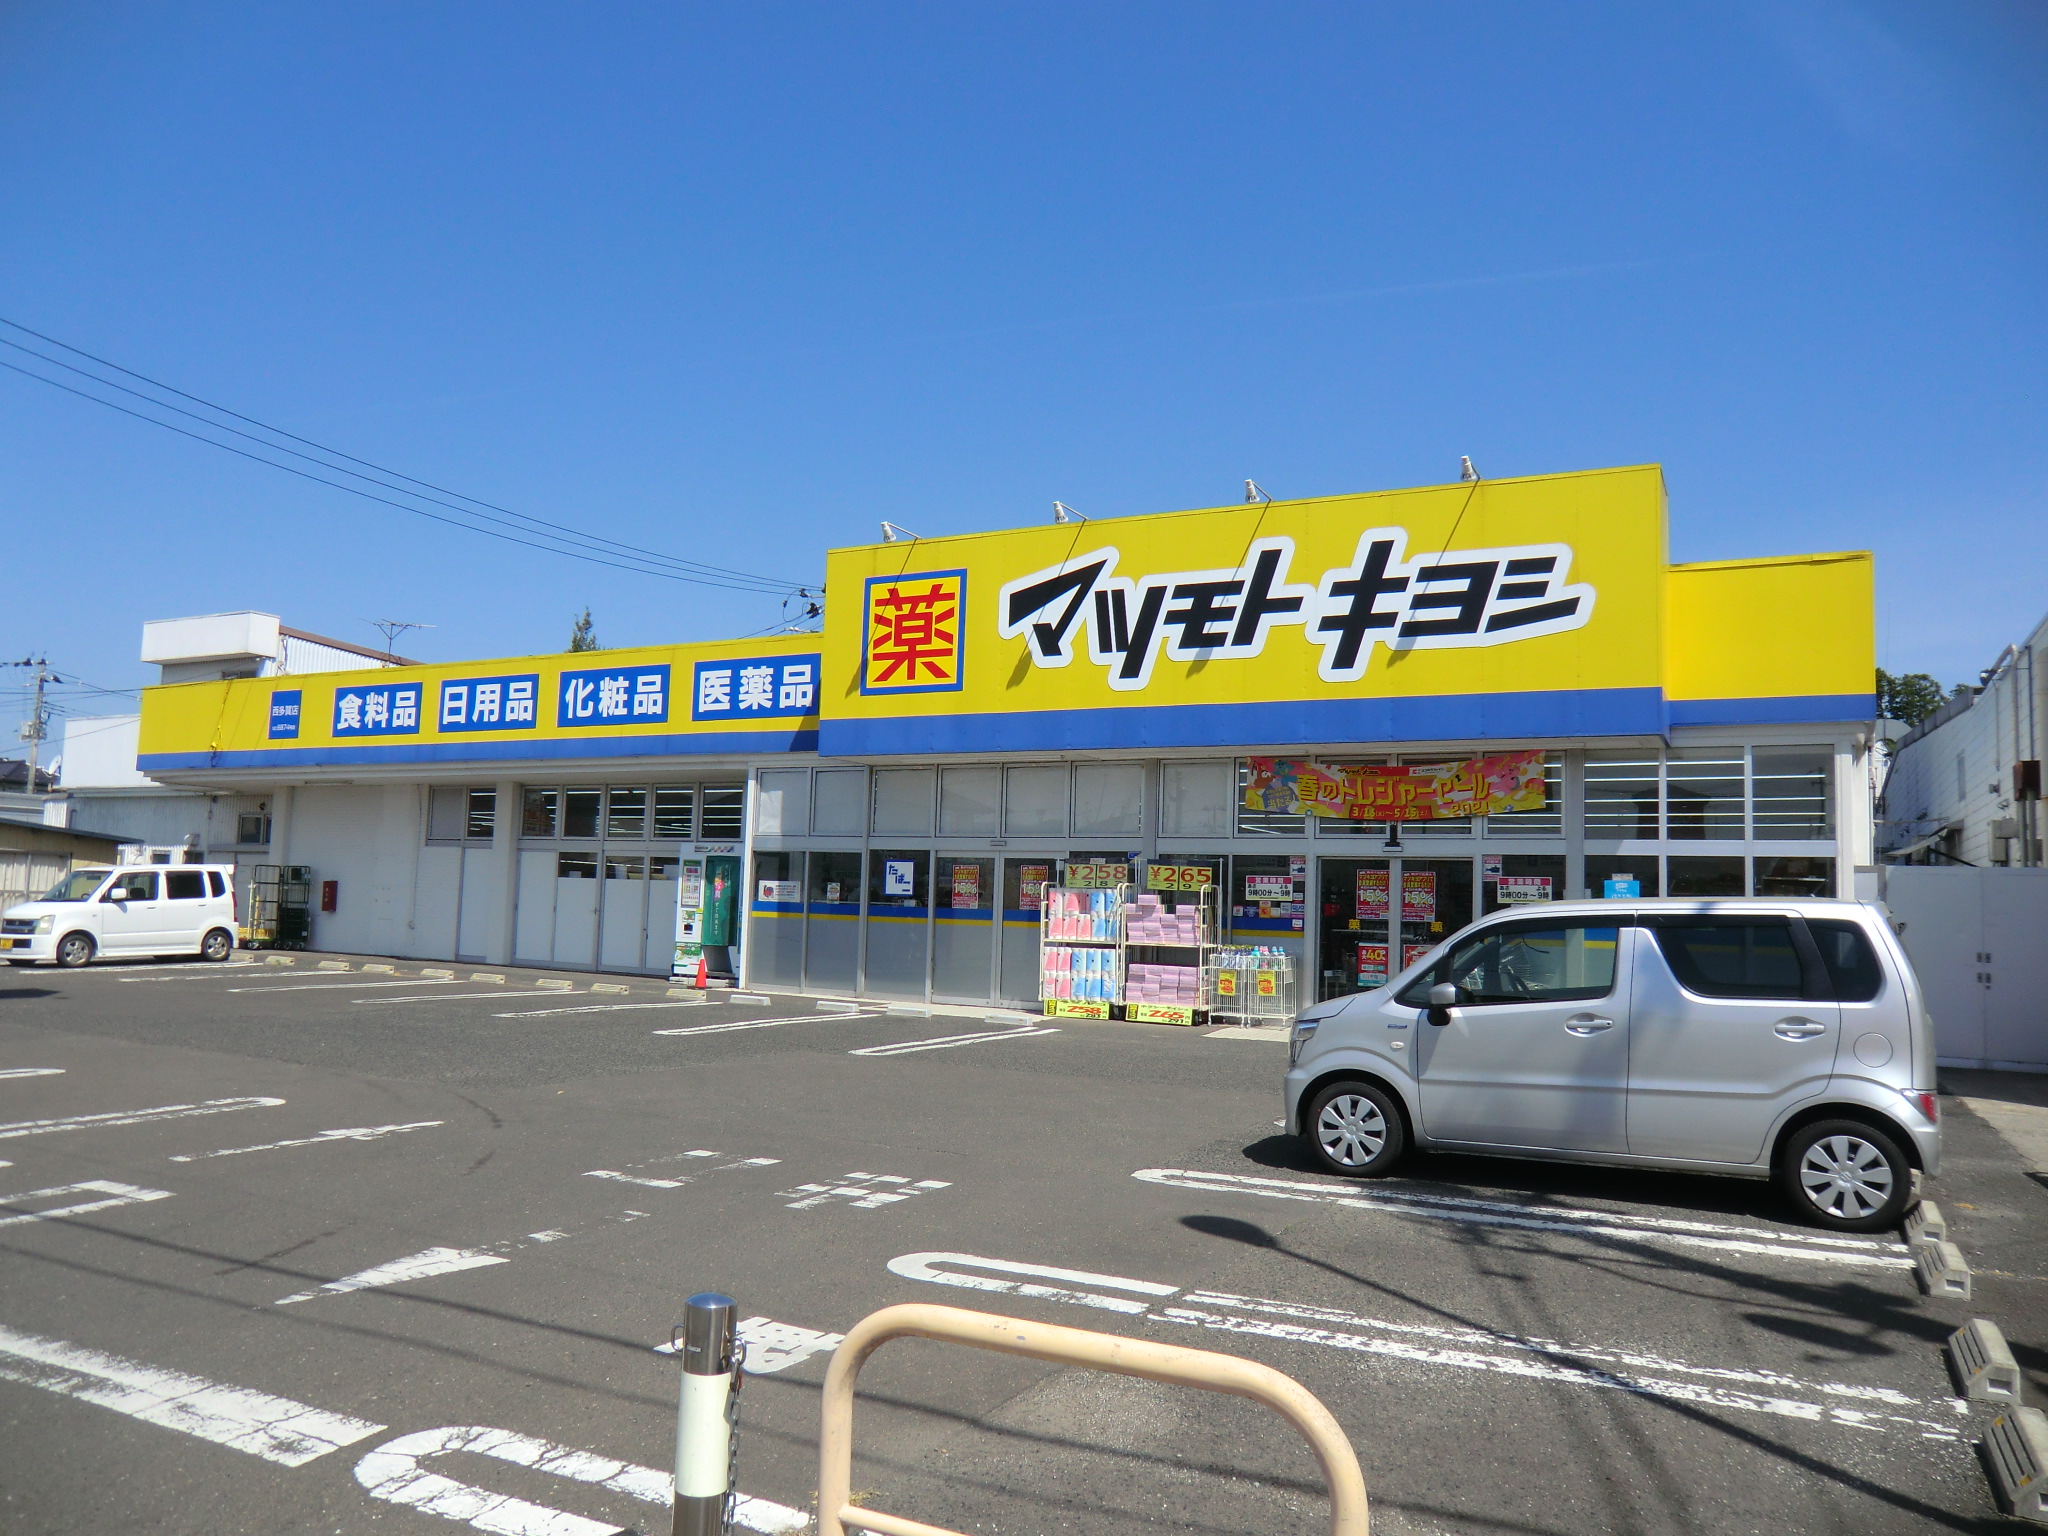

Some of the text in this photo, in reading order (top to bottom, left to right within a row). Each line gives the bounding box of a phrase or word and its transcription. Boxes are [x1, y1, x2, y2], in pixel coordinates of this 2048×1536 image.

[1006, 538, 1583, 680] マツモトキヨシ
[870, 583, 958, 685] 薬
[564, 674, 664, 719] 化粧品
[697, 664, 814, 713] 医薬品
[336, 691, 418, 731] 食料品
[441, 682, 534, 724] 日用品
[1298, 772, 1491, 806] 春のトレジャーセール
[1451, 801, 1491, 815] 2021
[1069, 866, 1127, 880] ¥258
[1150, 866, 1211, 883] ¥265
[953, 882, 977, 894] 15%
[1358, 889, 1389, 902] 15%
[1403, 891, 1434, 904] 15%
[1148, 1010, 1185, 1019] 265
